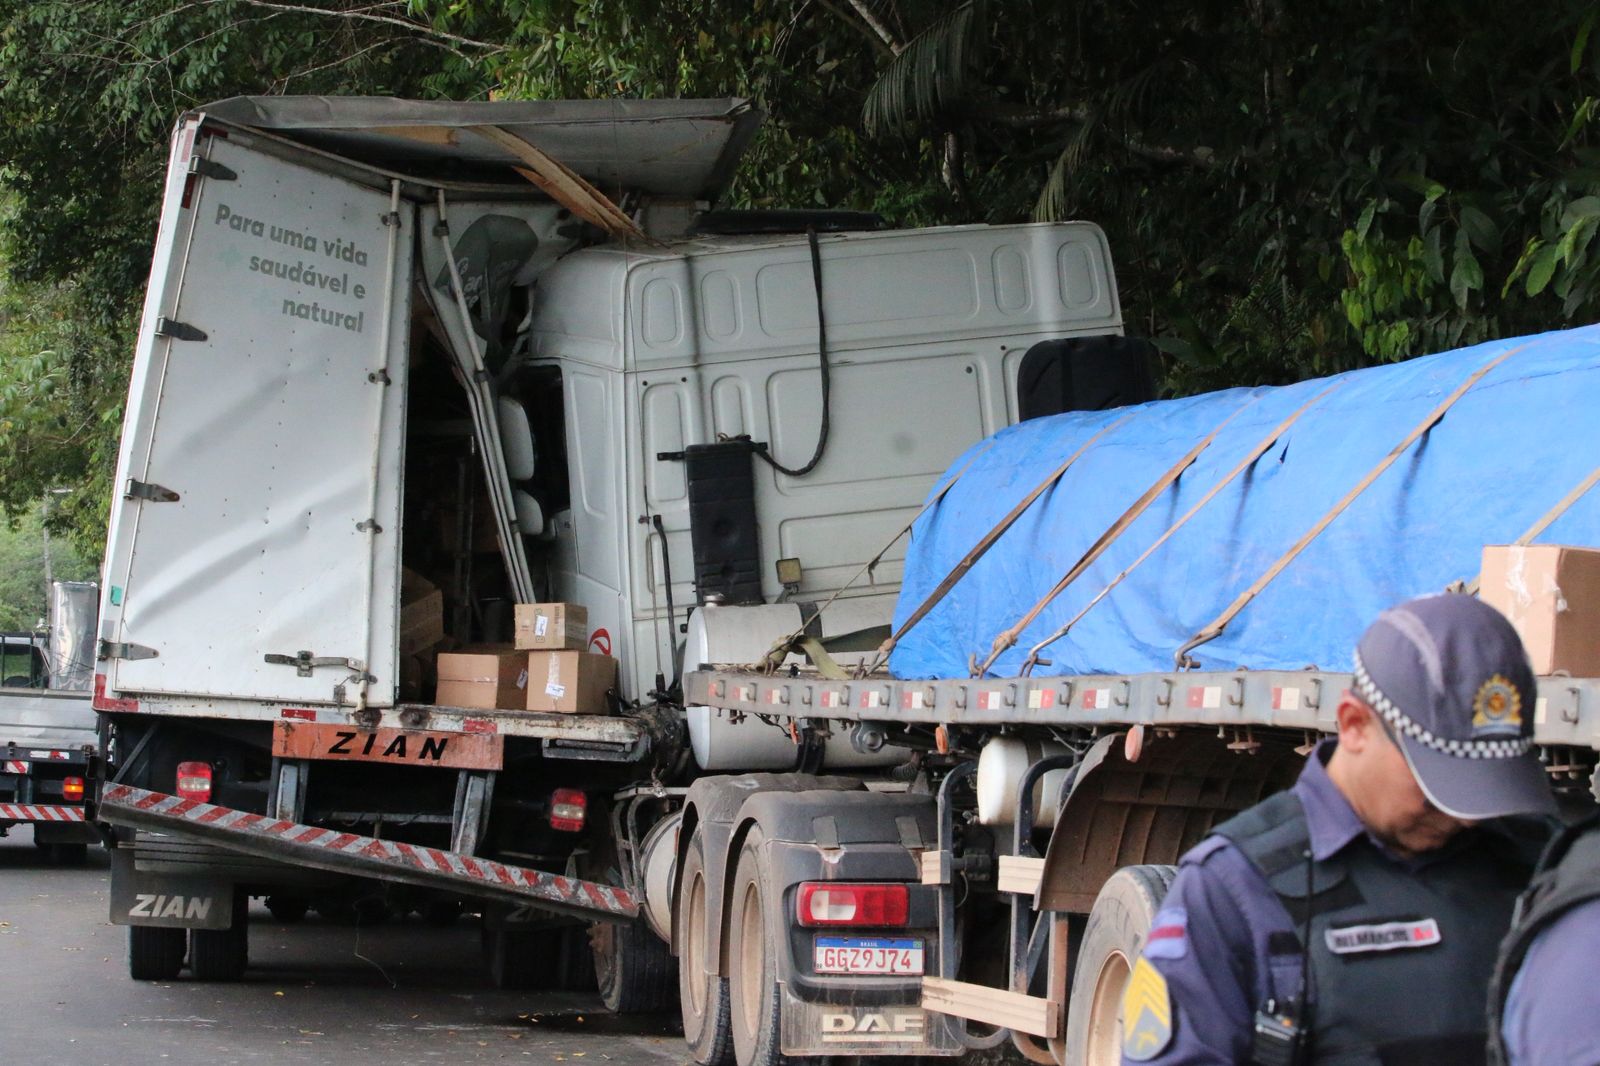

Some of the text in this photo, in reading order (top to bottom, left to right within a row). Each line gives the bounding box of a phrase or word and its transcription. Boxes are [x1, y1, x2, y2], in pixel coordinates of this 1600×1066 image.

[215, 203, 368, 267] Para uma vida
[249, 254, 366, 298] saudável e
[282, 299, 364, 333] natural
[328, 731, 448, 760] ZIAN
[128, 893, 212, 919] ZIAN
[824, 948, 911, 969] GGZ9J74
[823, 1013, 924, 1032] DAF
